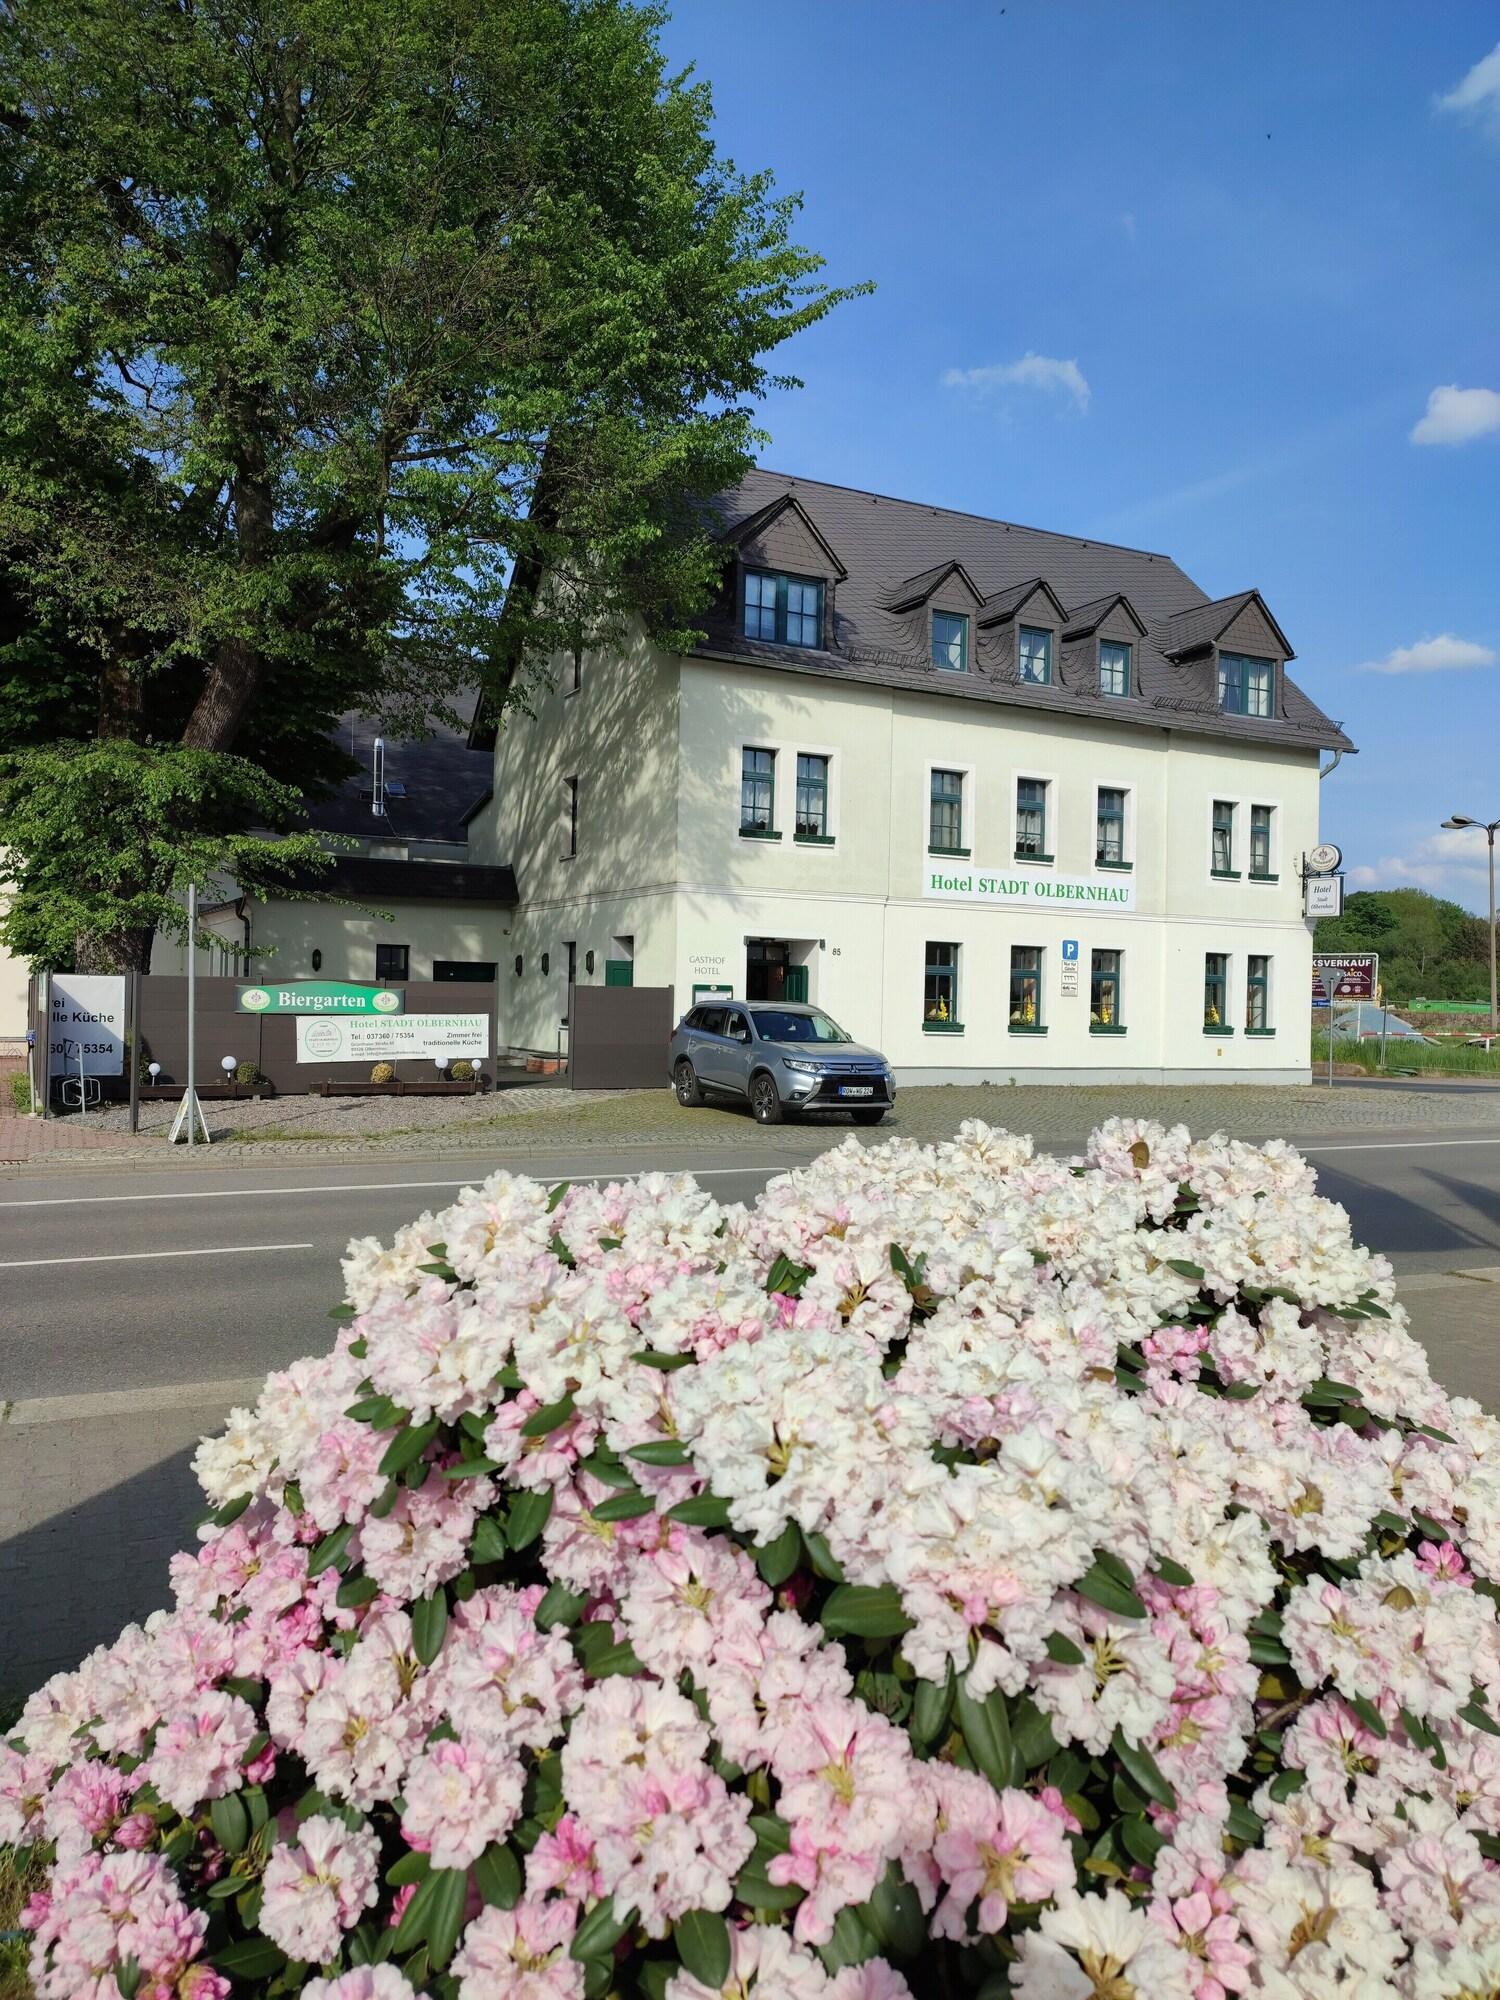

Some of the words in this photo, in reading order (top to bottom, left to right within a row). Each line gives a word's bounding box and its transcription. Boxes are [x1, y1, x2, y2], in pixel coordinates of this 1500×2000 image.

[930, 874, 972, 892] Hotel
[978, 878, 1030, 896] STADT
[1034, 882, 1129, 902] OLBERNHAU
[1314, 885, 1332, 894] Hotel
[832, 948, 841, 956] 85
[1067, 944, 1074, 957] P
[688, 956, 726, 964] GASTHOF
[694, 967, 720, 976] HOTEL
[52, 998, 64, 1008] ei
[278, 992, 366, 1010] Biergarten
[72, 1012, 114, 1022] Küche
[350, 1020, 378, 1028] Hotel
[417, 1019, 482, 1027] OLBERNHAU
